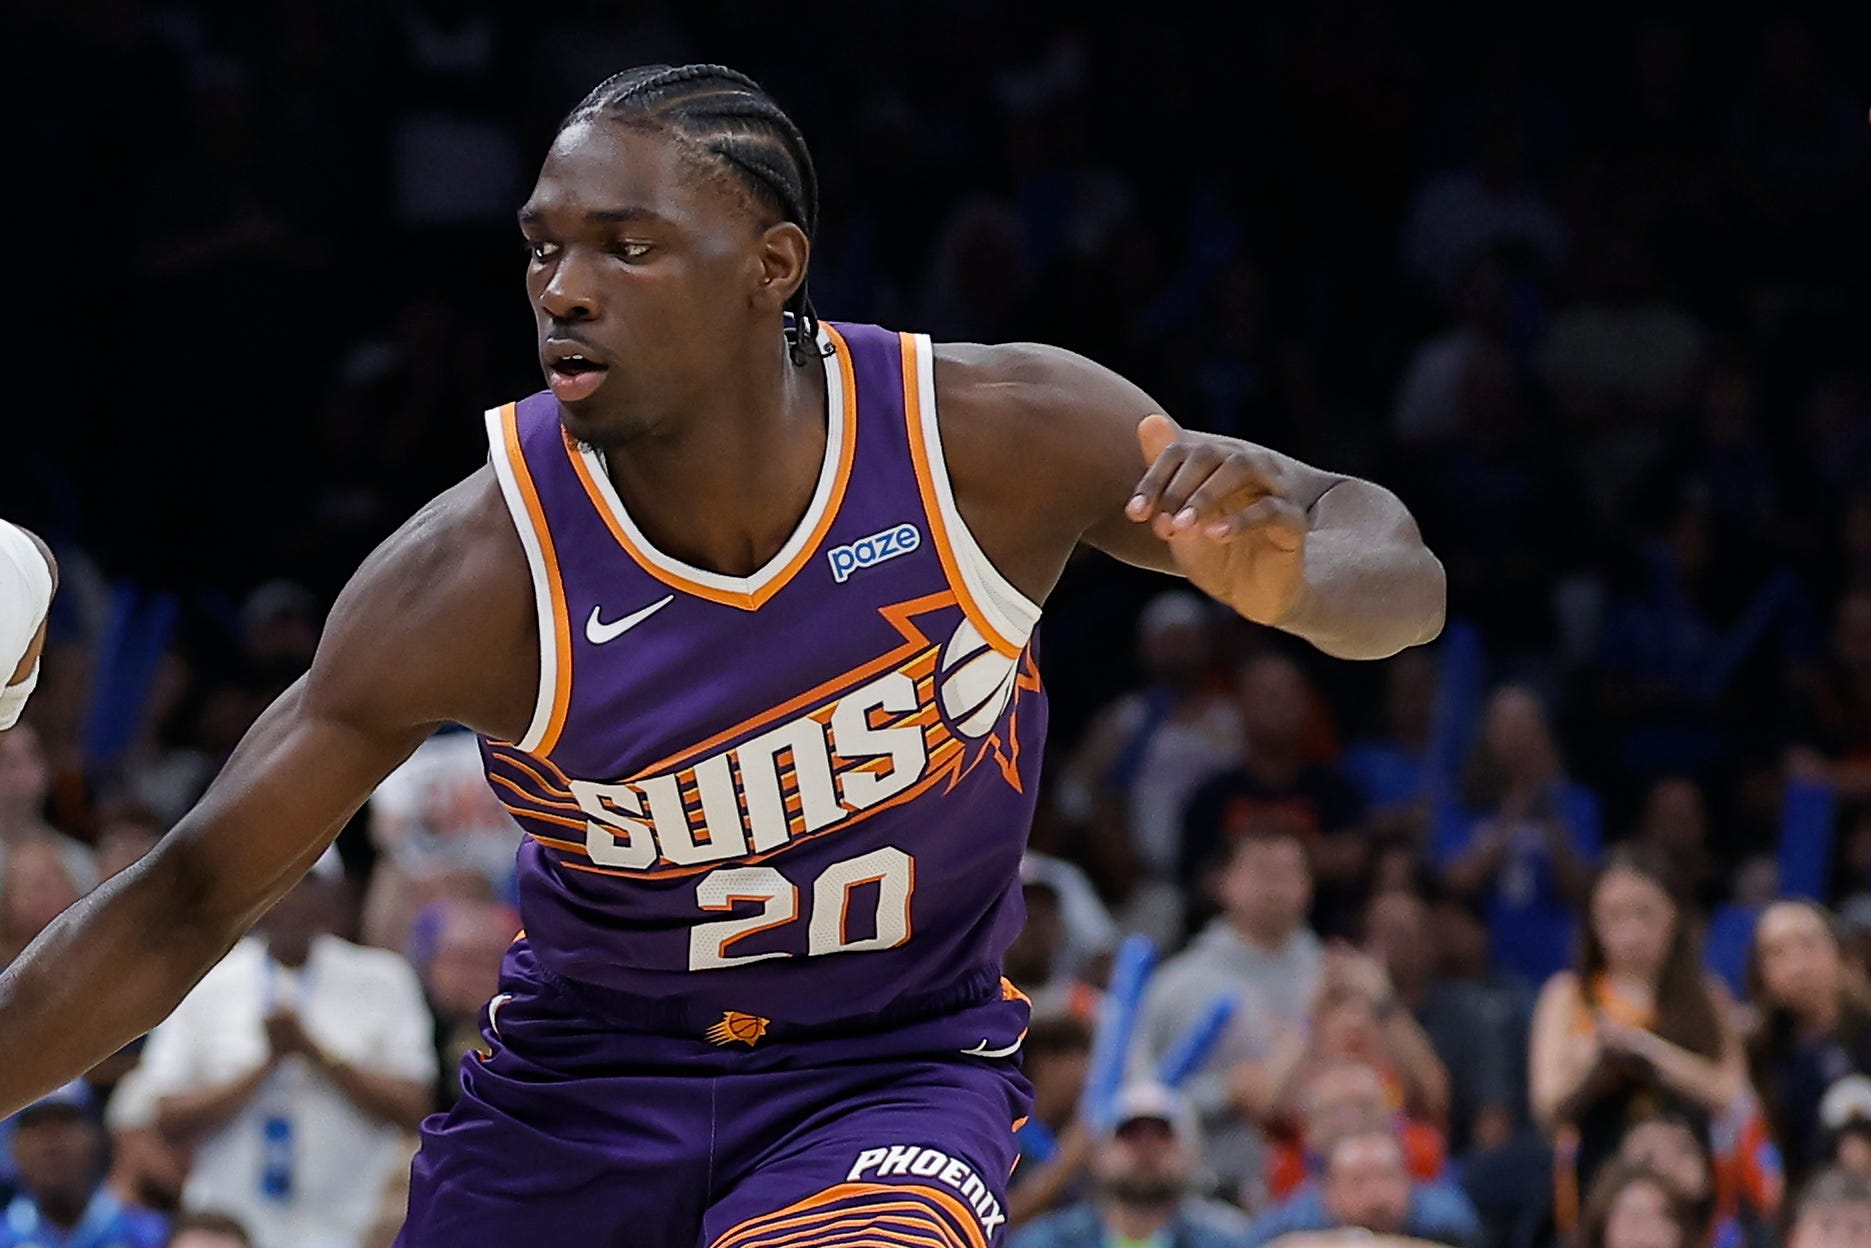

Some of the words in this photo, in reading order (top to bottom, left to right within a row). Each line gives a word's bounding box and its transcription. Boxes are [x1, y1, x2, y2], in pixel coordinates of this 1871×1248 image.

[831, 527, 916, 579] paze
[689, 846, 915, 971] 20
[846, 1145, 1006, 1240] PHOENIX
